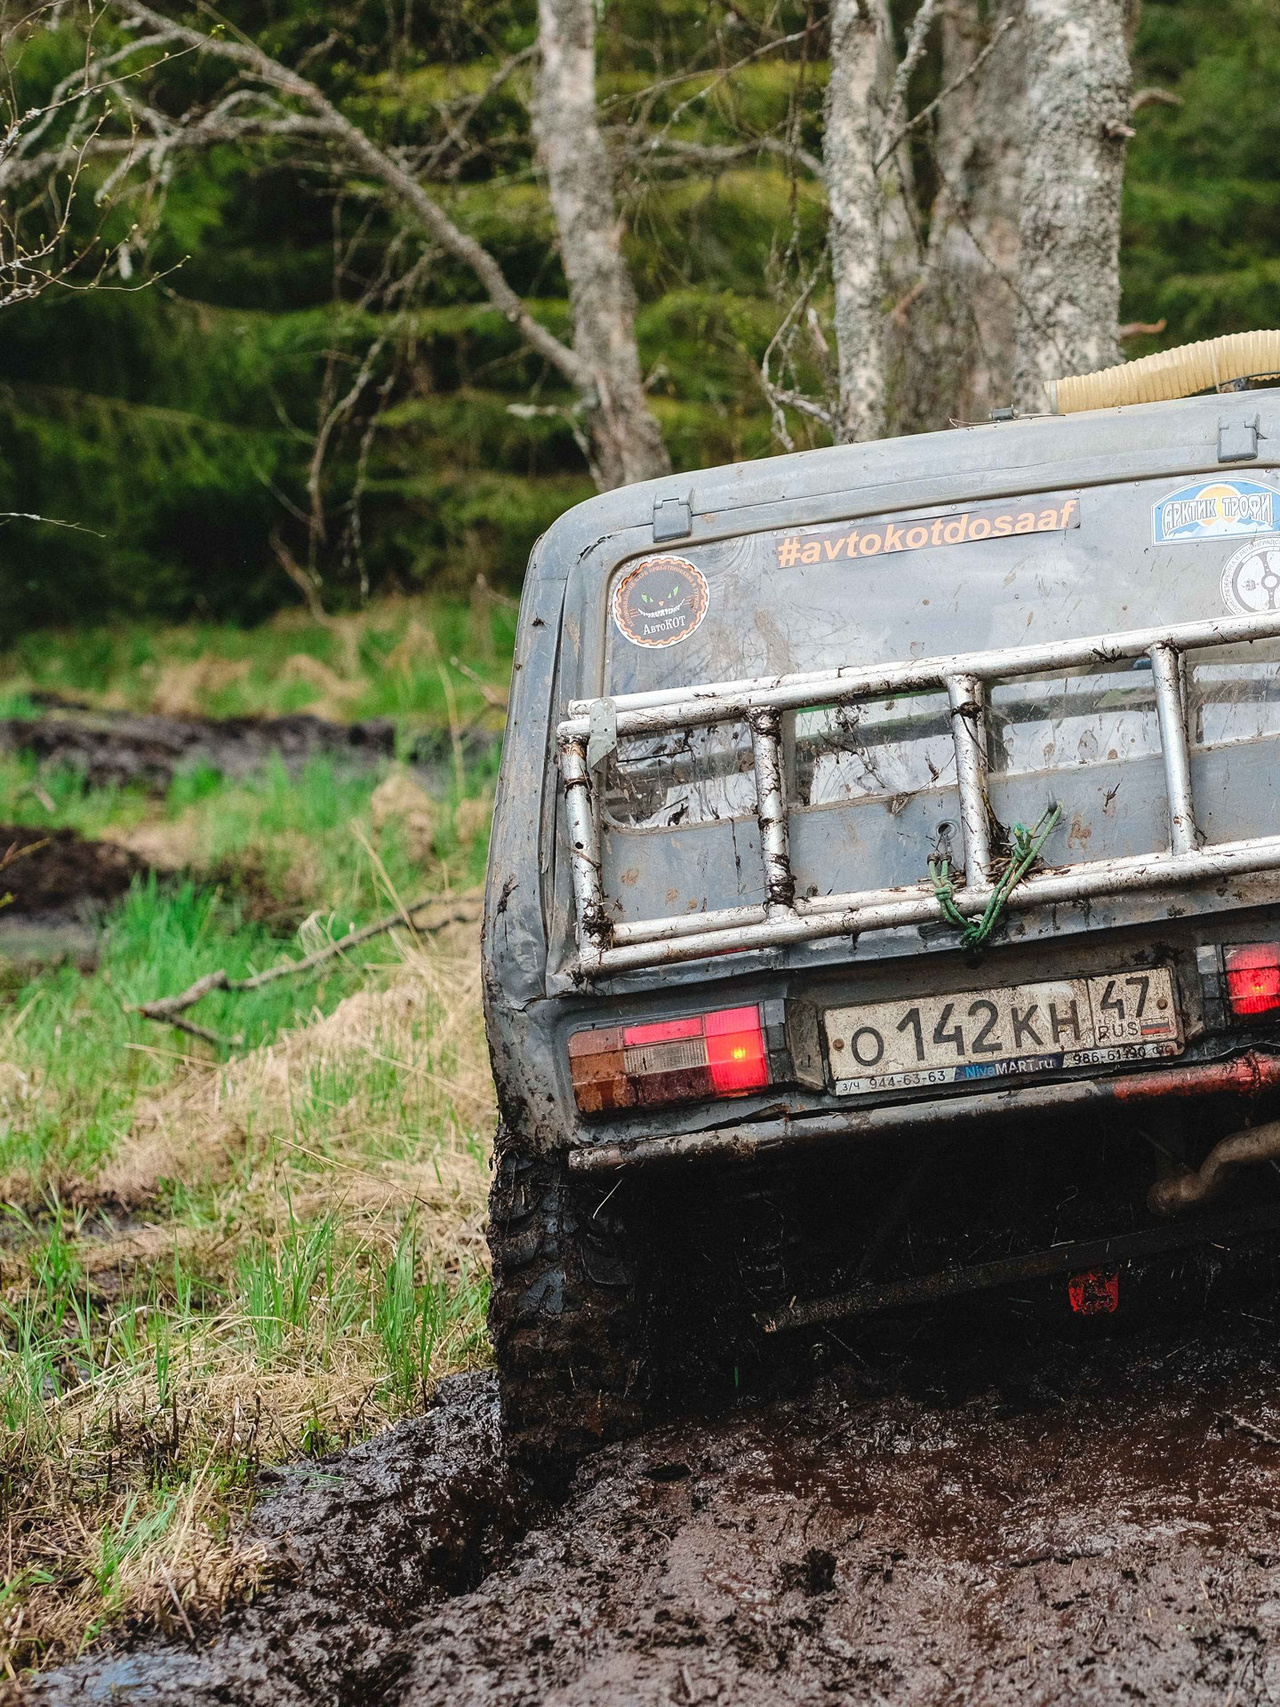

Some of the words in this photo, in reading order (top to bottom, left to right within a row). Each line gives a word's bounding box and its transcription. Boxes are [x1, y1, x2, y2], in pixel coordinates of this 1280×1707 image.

[1162, 499, 1217, 536] АРКТИК
[1222, 493, 1273, 525] ТРОФИ
[777, 500, 1077, 568] #avtokotdosaaf
[643, 616, 686, 635] АвтоКОТ
[1100, 975, 1149, 1019] 47
[1098, 1021, 1138, 1041] RUS
[965, 1059, 1054, 1079] NivaMART.ru
[869, 1071, 946, 1090] 944-63-63
